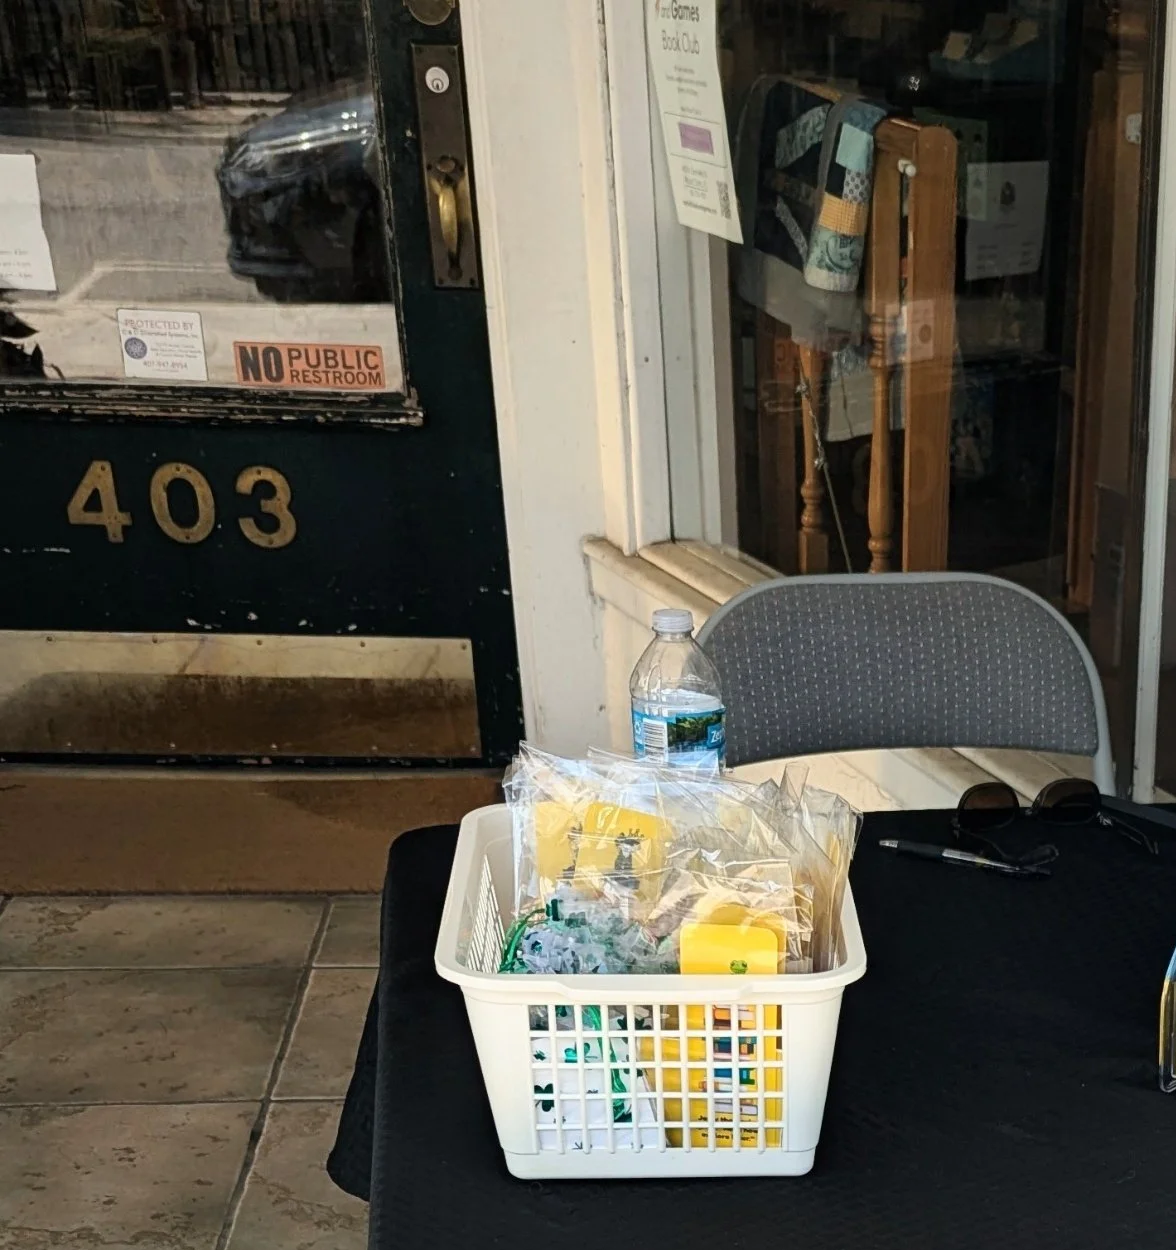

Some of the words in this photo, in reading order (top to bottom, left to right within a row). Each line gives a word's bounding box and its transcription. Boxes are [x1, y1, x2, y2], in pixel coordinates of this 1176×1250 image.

[671, 0, 700, 22] Games
[662, 29, 681, 51] Book
[682, 32, 700, 54] Club
[124, 319, 182, 330] PROTECTED
[183, 322, 194, 331] BY
[238, 345, 285, 383] NO
[287, 348, 380, 371] PUBLIC
[290, 369, 382, 386] RESTROOM
[66, 460, 297, 548] 403
